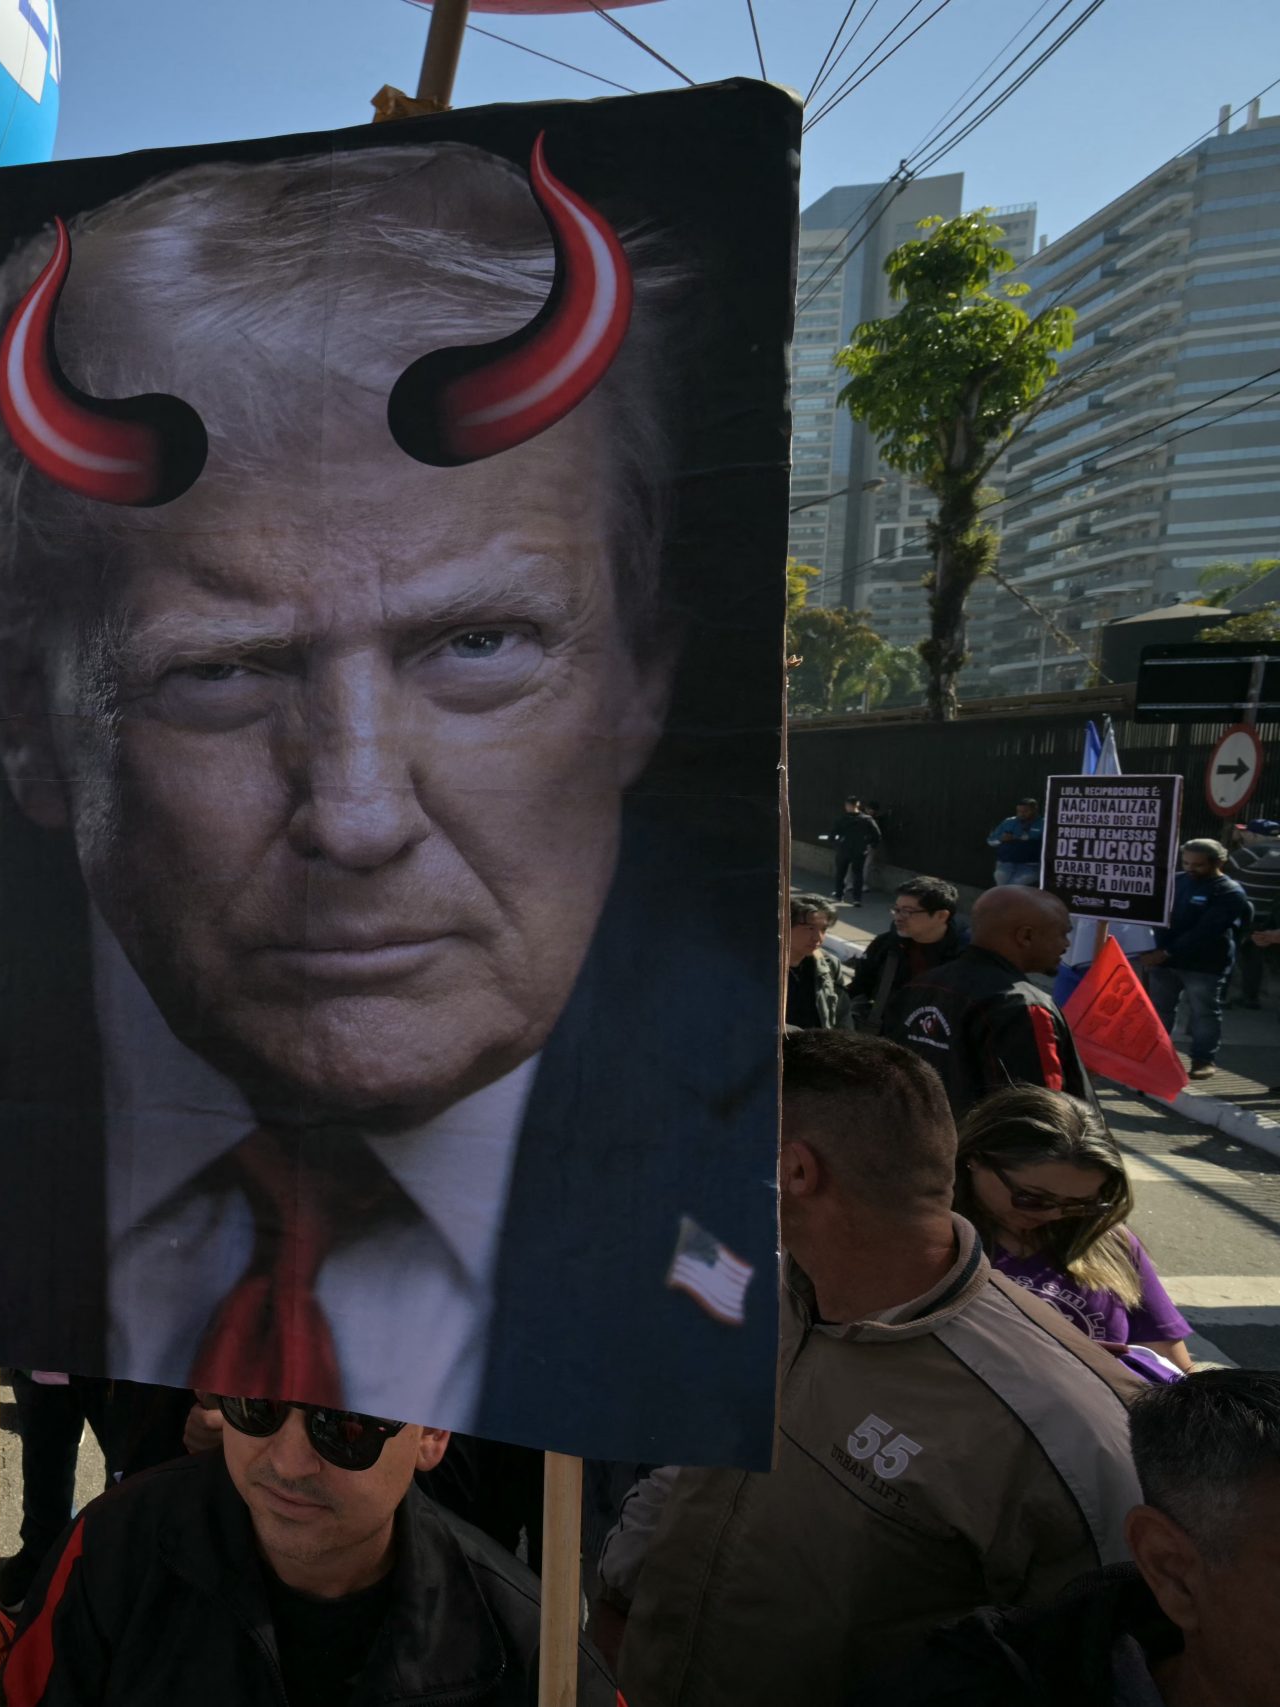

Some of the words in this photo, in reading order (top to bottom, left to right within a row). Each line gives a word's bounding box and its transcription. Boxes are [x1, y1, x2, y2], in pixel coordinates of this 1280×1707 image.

[1061, 799, 1157, 814] NACIONALIZAR
[1060, 814, 1110, 825] EMPRESAS
[1113, 815, 1133, 826] DOS
[1137, 816, 1157, 826] EUA
[1058, 827, 1096, 839] PROIBIR
[1099, 828, 1157, 842] REMESSAS
[1056, 839, 1078, 857] DE
[1083, 841, 1156, 862] LUCROS
[1056, 861, 1092, 874] PARAR
[1095, 863, 1109, 876] DE
[1113, 865, 1153, 879] PAGAR
[1099, 879, 1106, 890] A
[1110, 878, 1152, 894] DÍVIDA
[847, 1413, 924, 1479] 55
[830, 1443, 869, 1482] URBAN
[869, 1474, 909, 1510] LIFE
